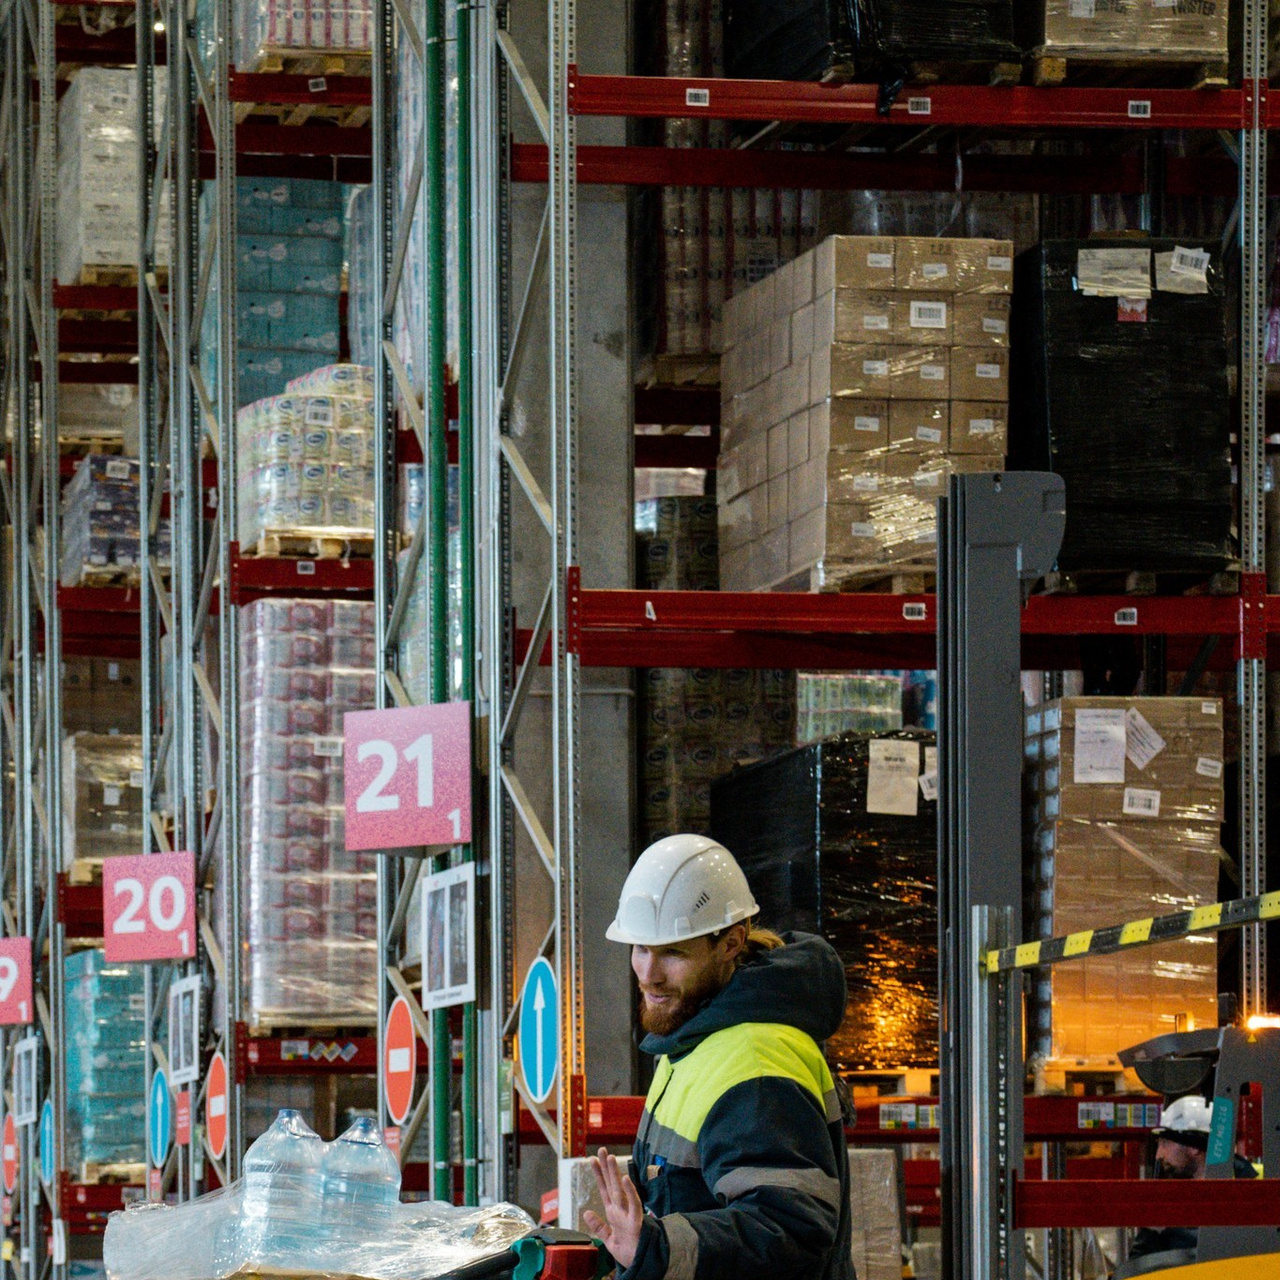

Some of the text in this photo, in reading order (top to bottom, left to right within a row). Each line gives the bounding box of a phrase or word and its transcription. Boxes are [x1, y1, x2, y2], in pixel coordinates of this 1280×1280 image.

[356, 733, 434, 813] 21
[447, 807, 461, 840] 1
[113, 875, 187, 934] 20
[177, 930, 189, 954] 1
[18, 1001, 28, 1021] 1
